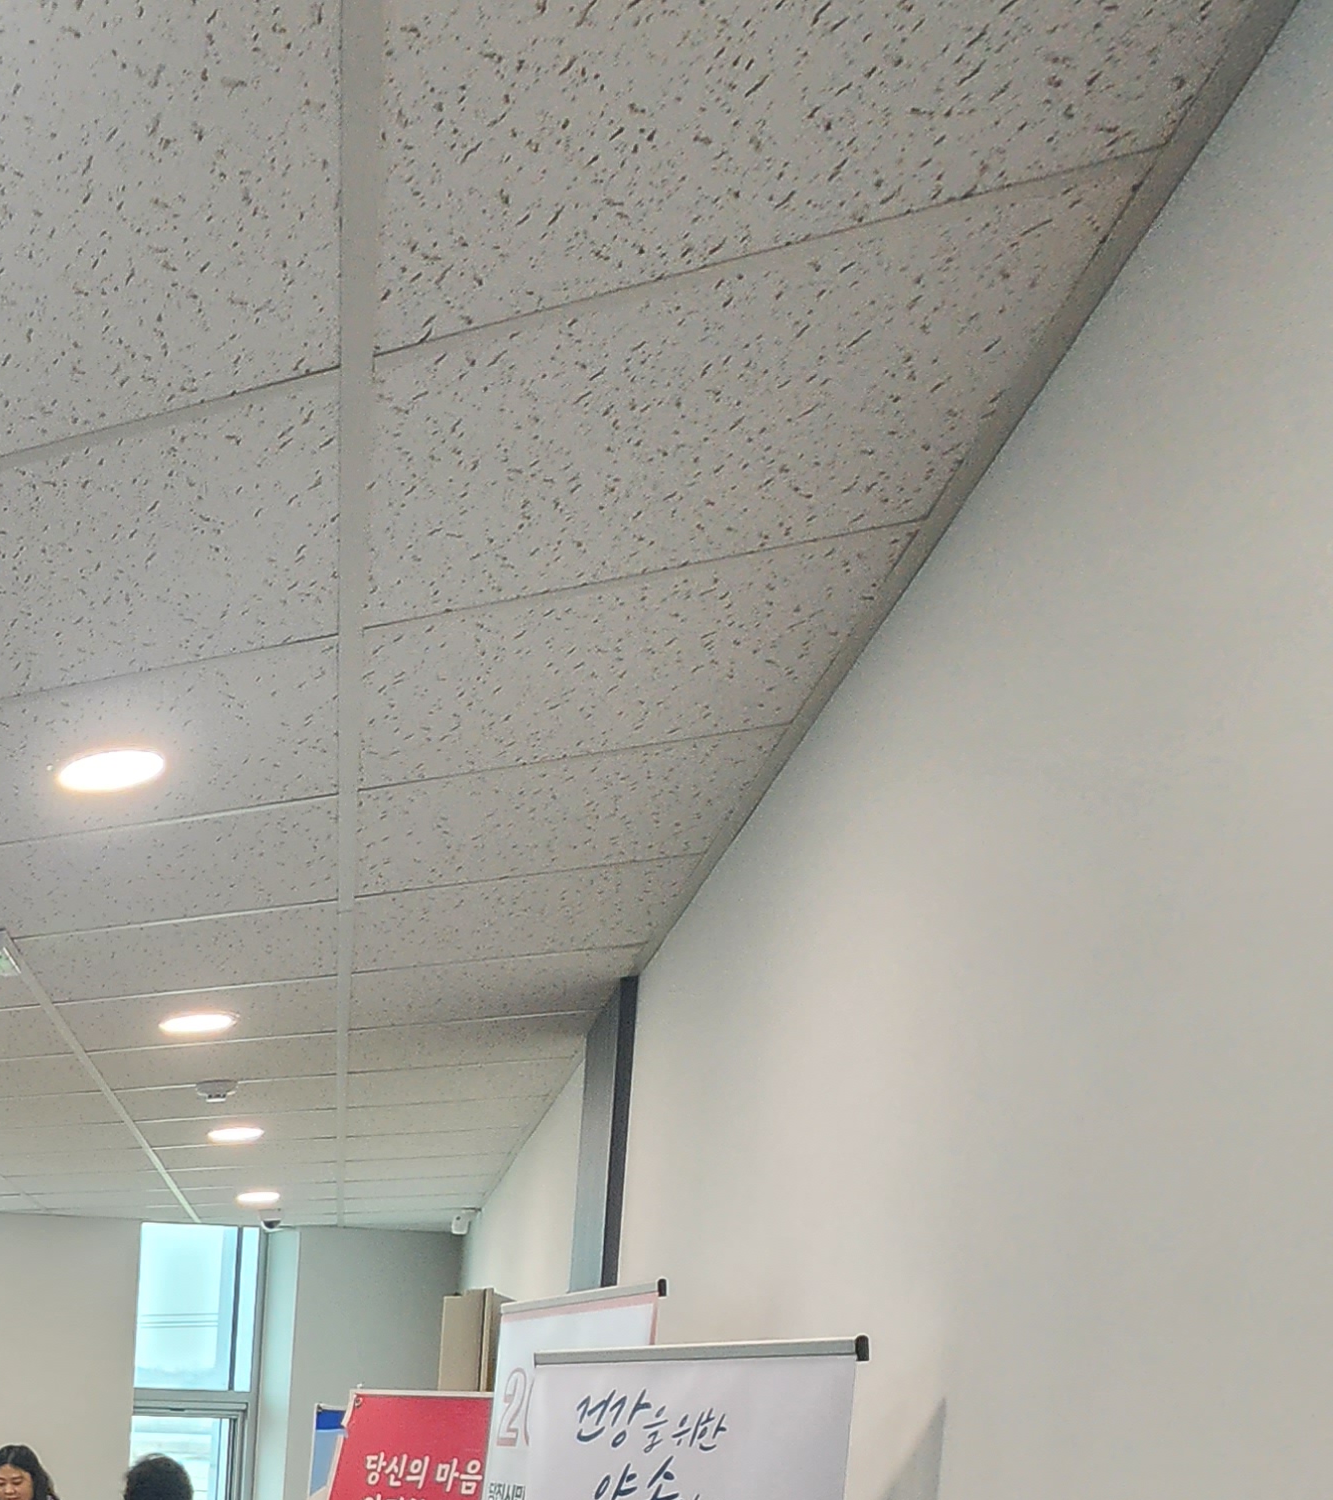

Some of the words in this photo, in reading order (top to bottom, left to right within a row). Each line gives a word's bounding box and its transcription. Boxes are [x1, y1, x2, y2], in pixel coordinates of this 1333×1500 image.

[576, 1388, 669, 1454] 건강을
[671, 1407, 728, 1452] 위한
[365, 1450, 430, 1490] 당신의
[435, 1457, 483, 1495] 마음
